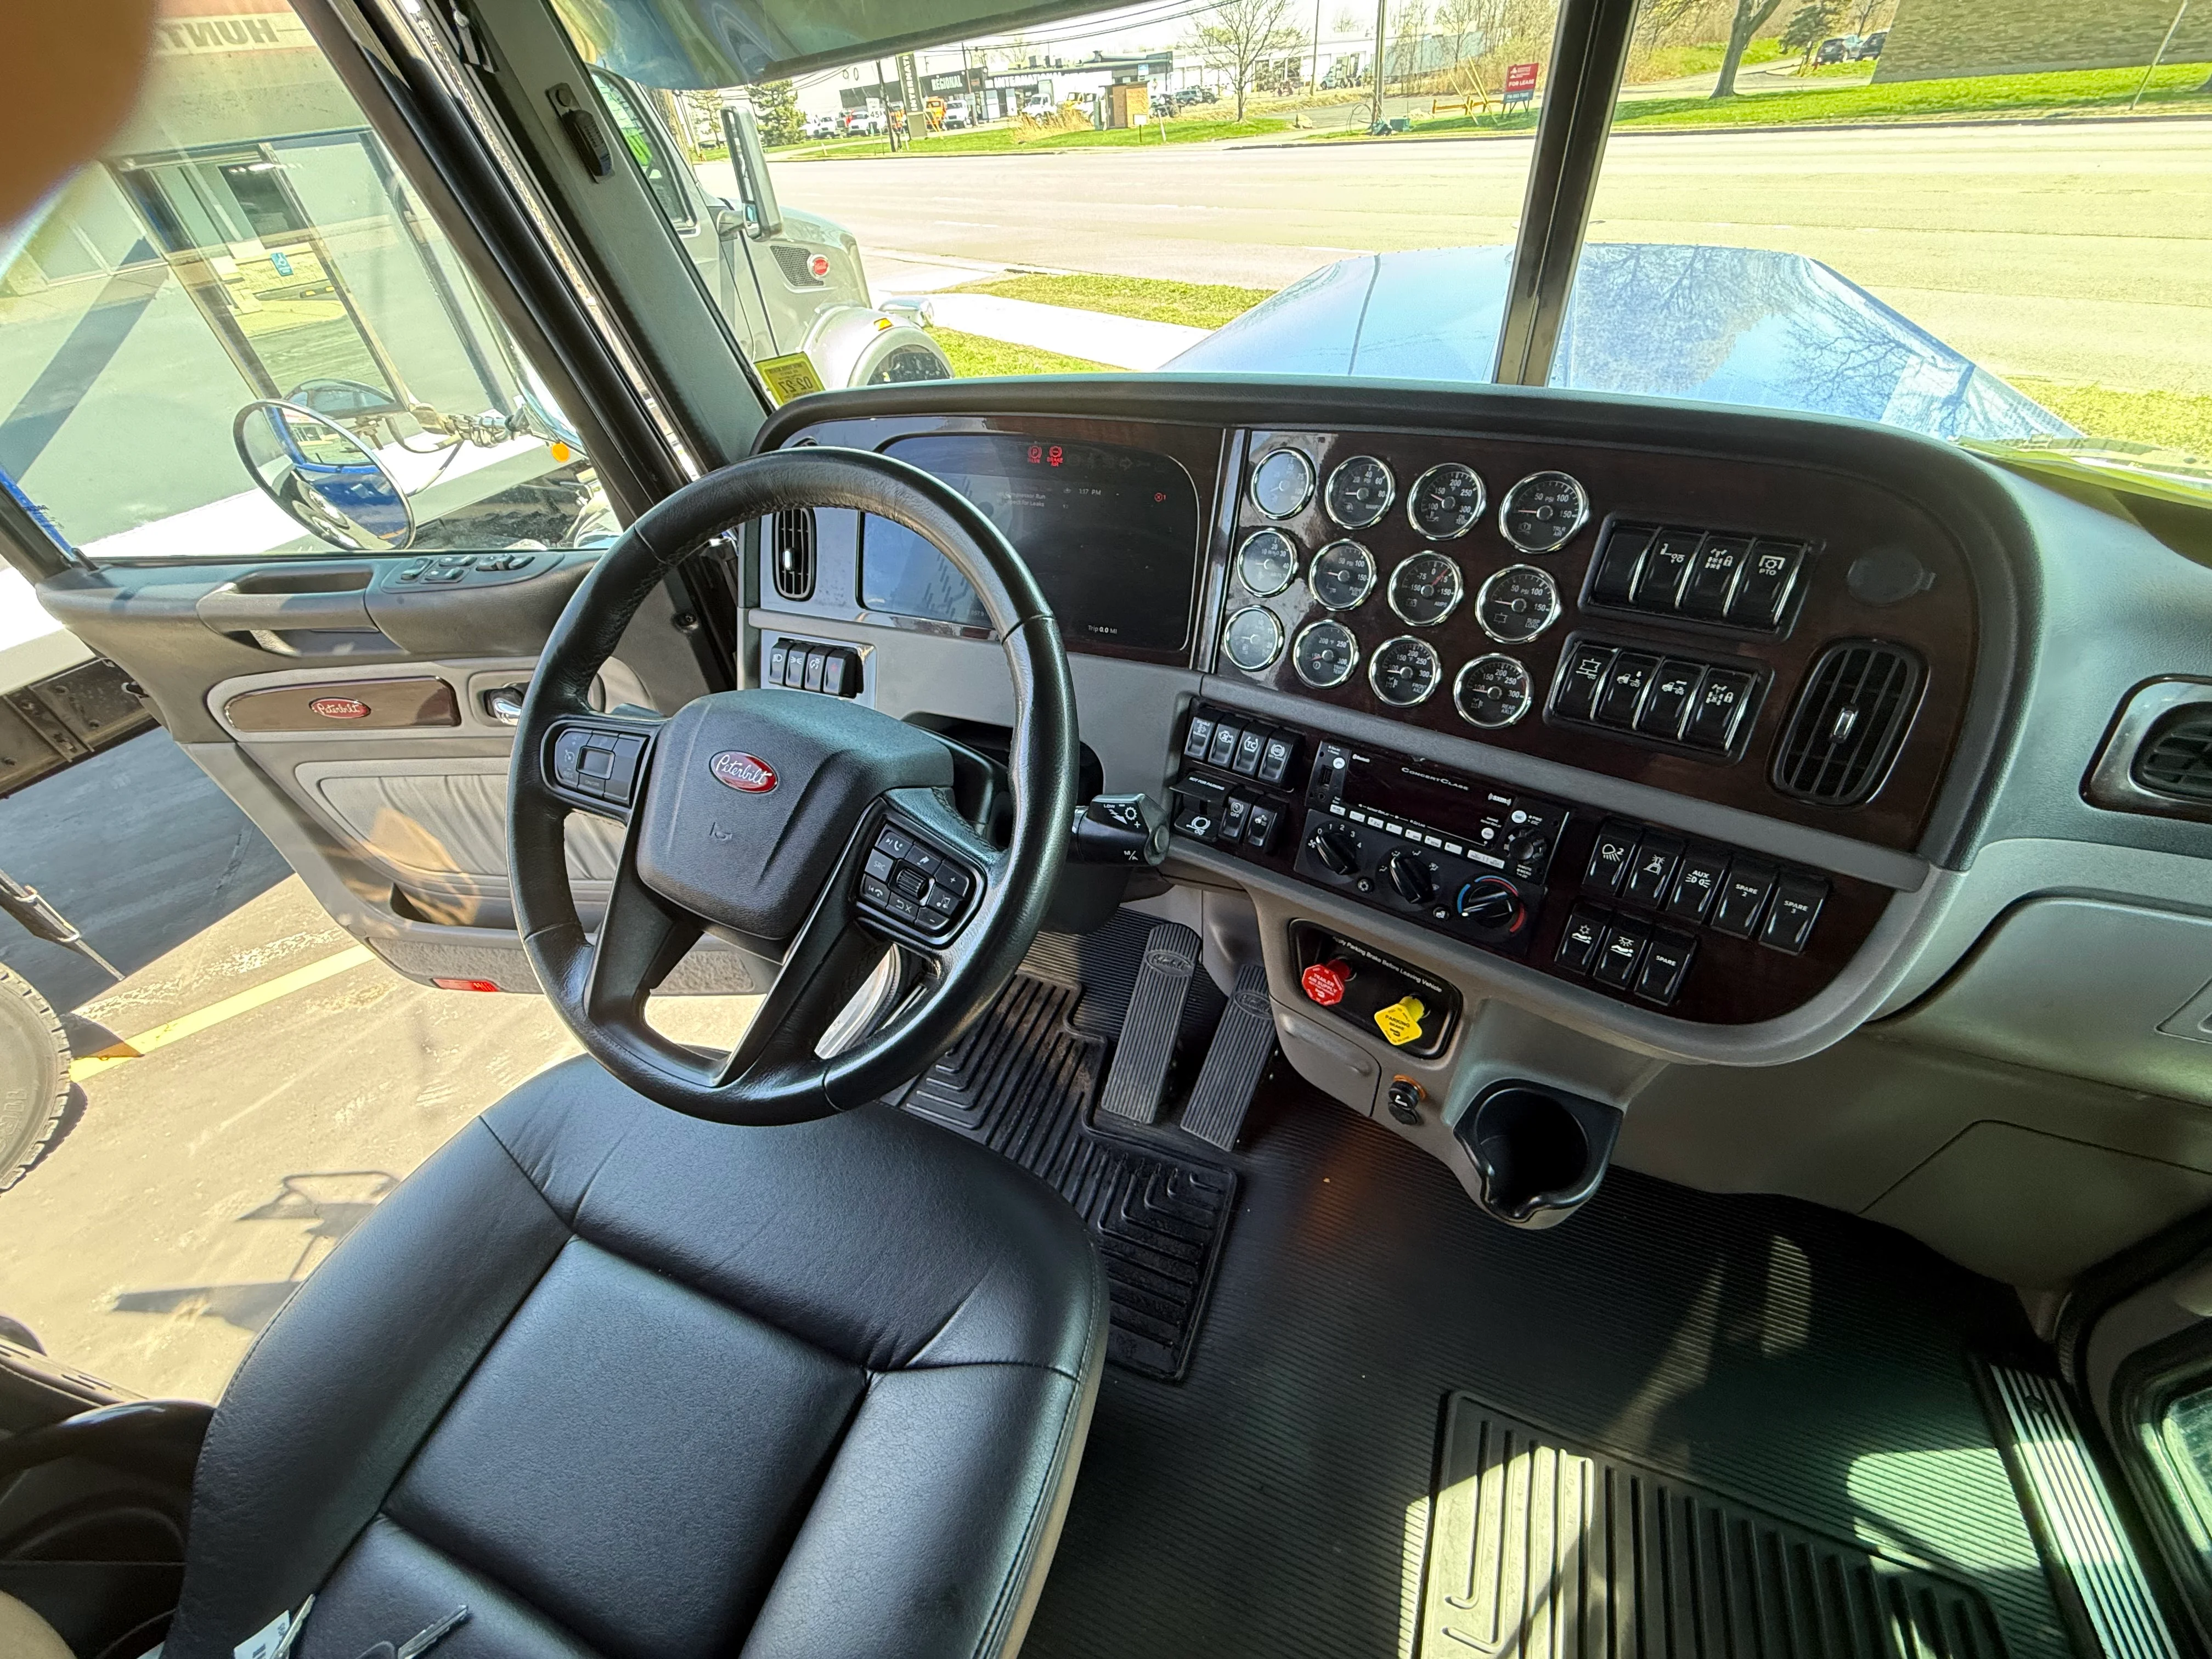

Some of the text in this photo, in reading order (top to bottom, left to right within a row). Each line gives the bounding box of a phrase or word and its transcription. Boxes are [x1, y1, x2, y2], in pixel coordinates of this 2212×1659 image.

[902, 55, 918, 111] INTERNATI
[1449, 479, 1462, 487] 200
[1557, 494, 1569, 503] 100
[1357, 573, 1367, 582] 150
[1531, 588, 1543, 596] 100
[1088, 625, 1098, 633] Trip
[1504, 677, 1517, 685] 250
[317, 703, 360, 714] Peterbilt
[715, 754, 772, 785] Peterbilt
[1206, 782, 1225, 791] PARKING
[873, 860, 886, 872] SRC
[1692, 870, 1709, 879] AUX
[1735, 883, 1758, 895] SPARE
[1784, 900, 1809, 912] SPARE
[1656, 955, 1676, 967] SPARE
[1347, 942, 1366, 956] Parking
[1366, 952, 1382, 963] Brake
[1382, 960, 1400, 972] Before
[1400, 968, 1422, 984] Leaving
[1422, 979, 1442, 993] Vehicle
[1314, 973, 1335, 987] TRAILER
[1317, 980, 1338, 994] SUPPLY
[1385, 1014, 1410, 1028] PARKING
[1389, 1022, 1404, 1031] BRAKE
